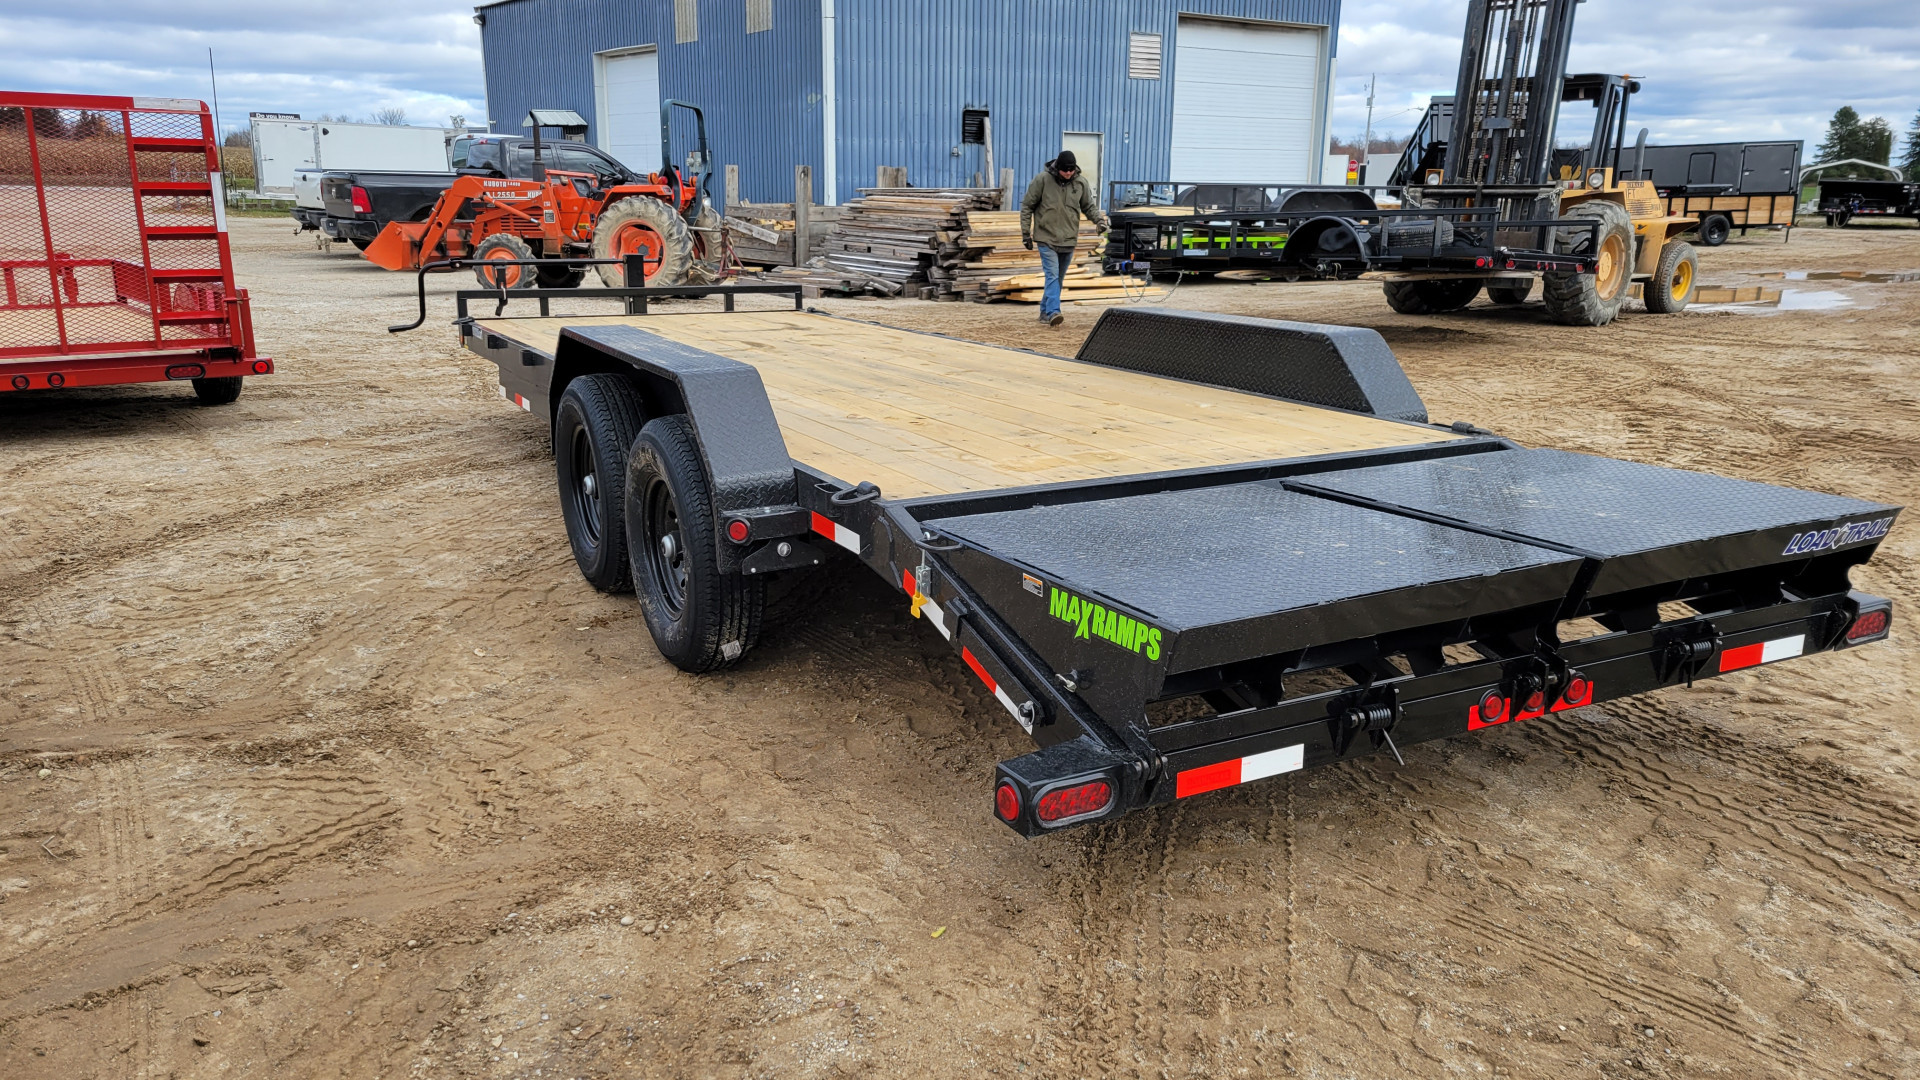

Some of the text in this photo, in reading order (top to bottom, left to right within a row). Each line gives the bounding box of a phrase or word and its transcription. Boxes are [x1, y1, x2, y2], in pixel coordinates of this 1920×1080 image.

[483, 180, 507, 188] KUBOTA
[1781, 516, 1894, 556] LOAD TRAIL
[1049, 586, 1163, 662] MAXRAMPS
